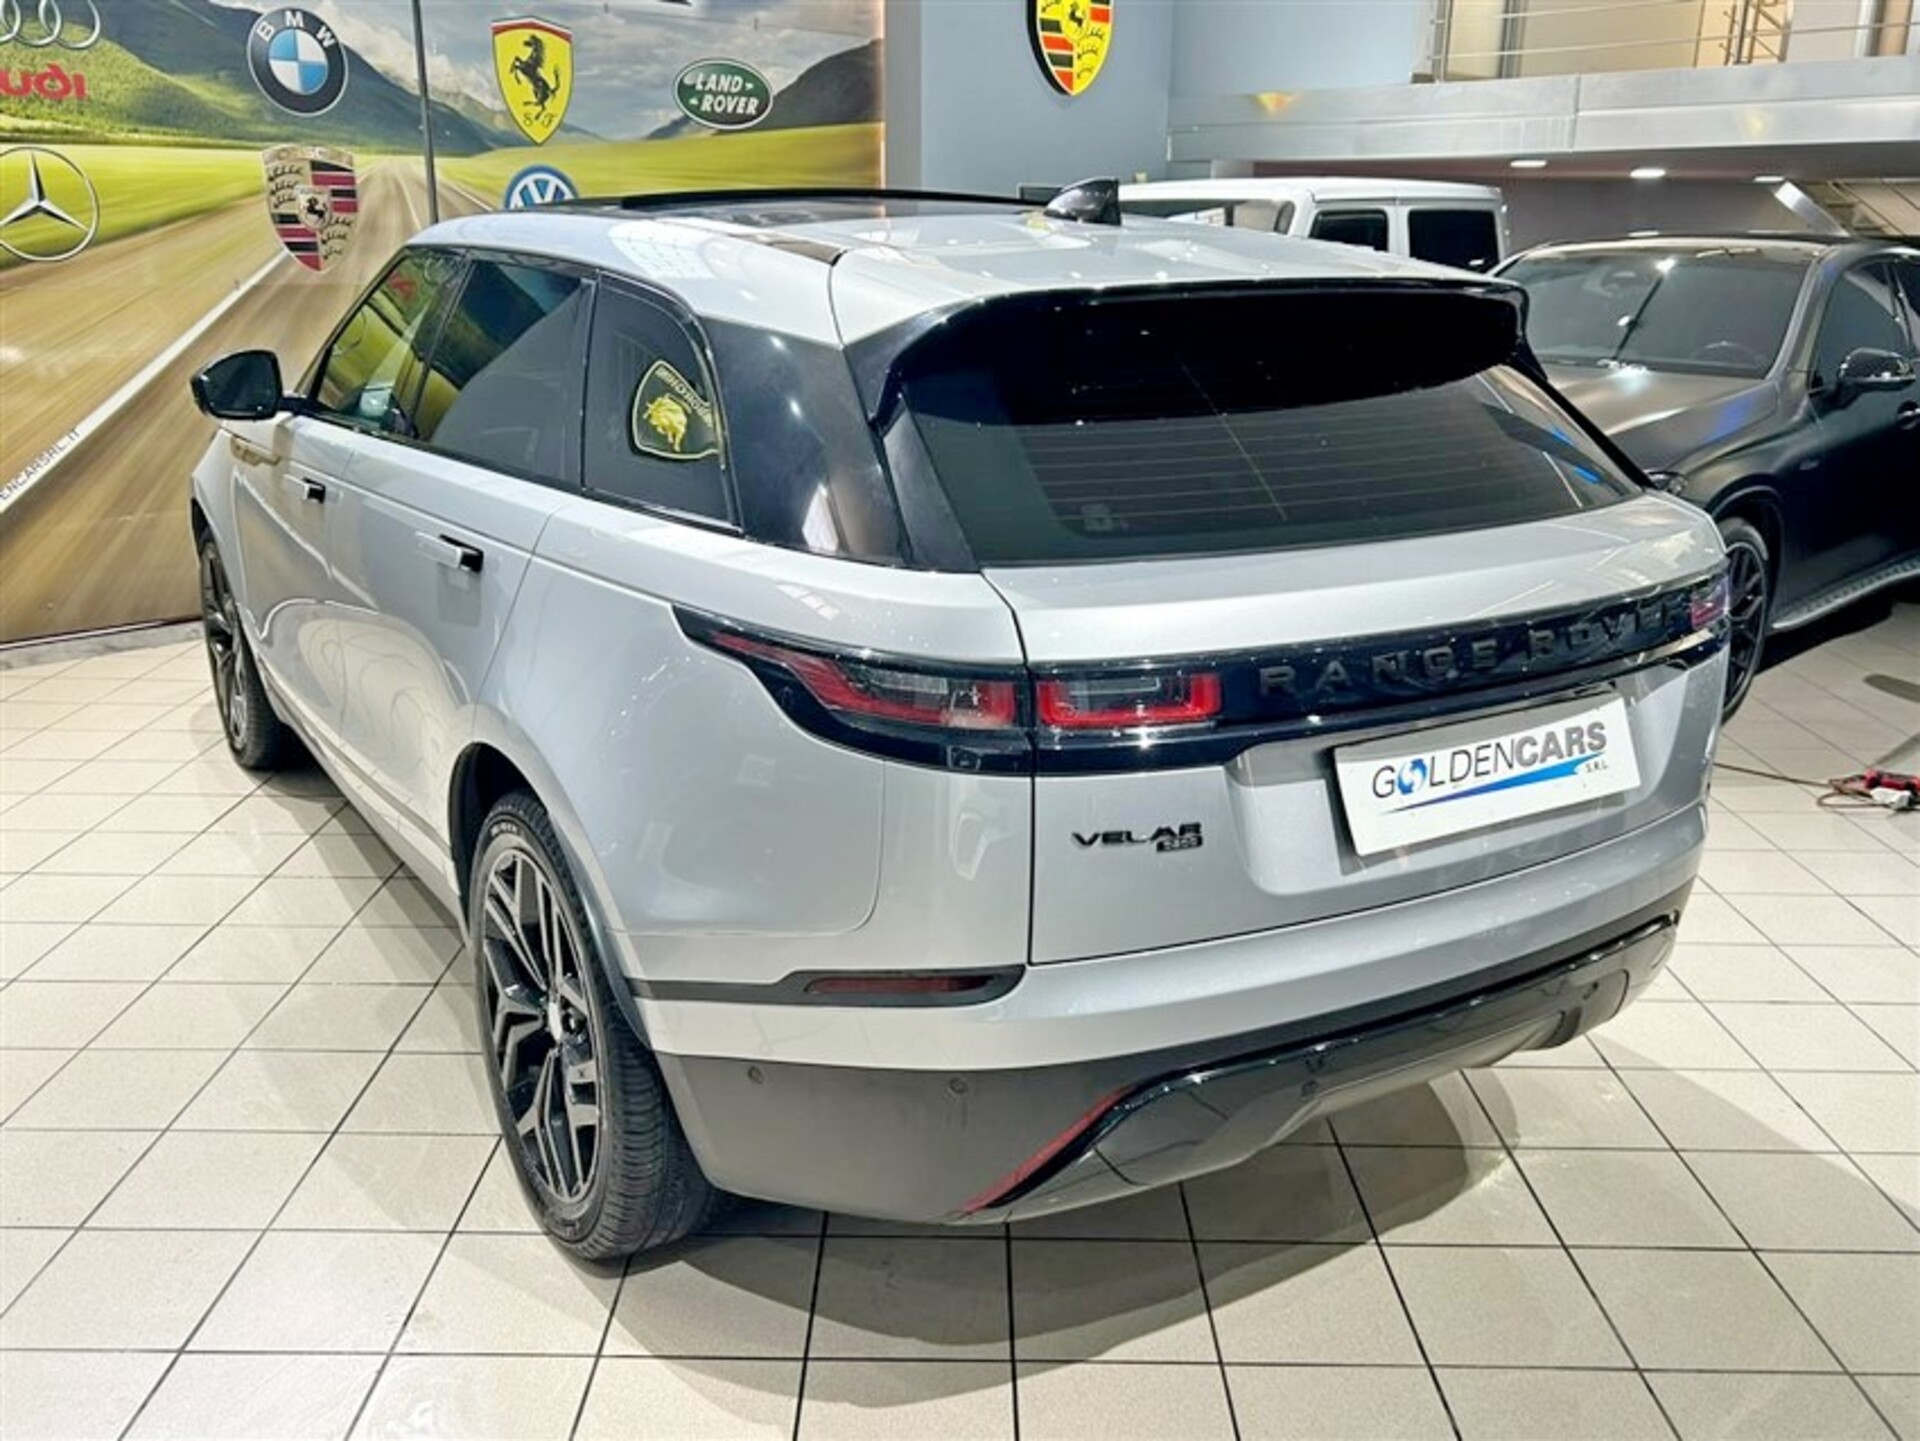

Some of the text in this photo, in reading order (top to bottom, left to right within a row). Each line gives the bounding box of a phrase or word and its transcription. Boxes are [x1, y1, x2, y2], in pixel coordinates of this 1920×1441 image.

[256, 10, 336, 48] BMW
[0, 63, 86, 100] udi
[695, 73, 744, 93] LAND
[701, 94, 760, 116] ROVER
[1259, 639, 1498, 698] RANGE
[1371, 721, 1608, 799] GOLDENCARS
[1072, 822, 1202, 847] VELAR
